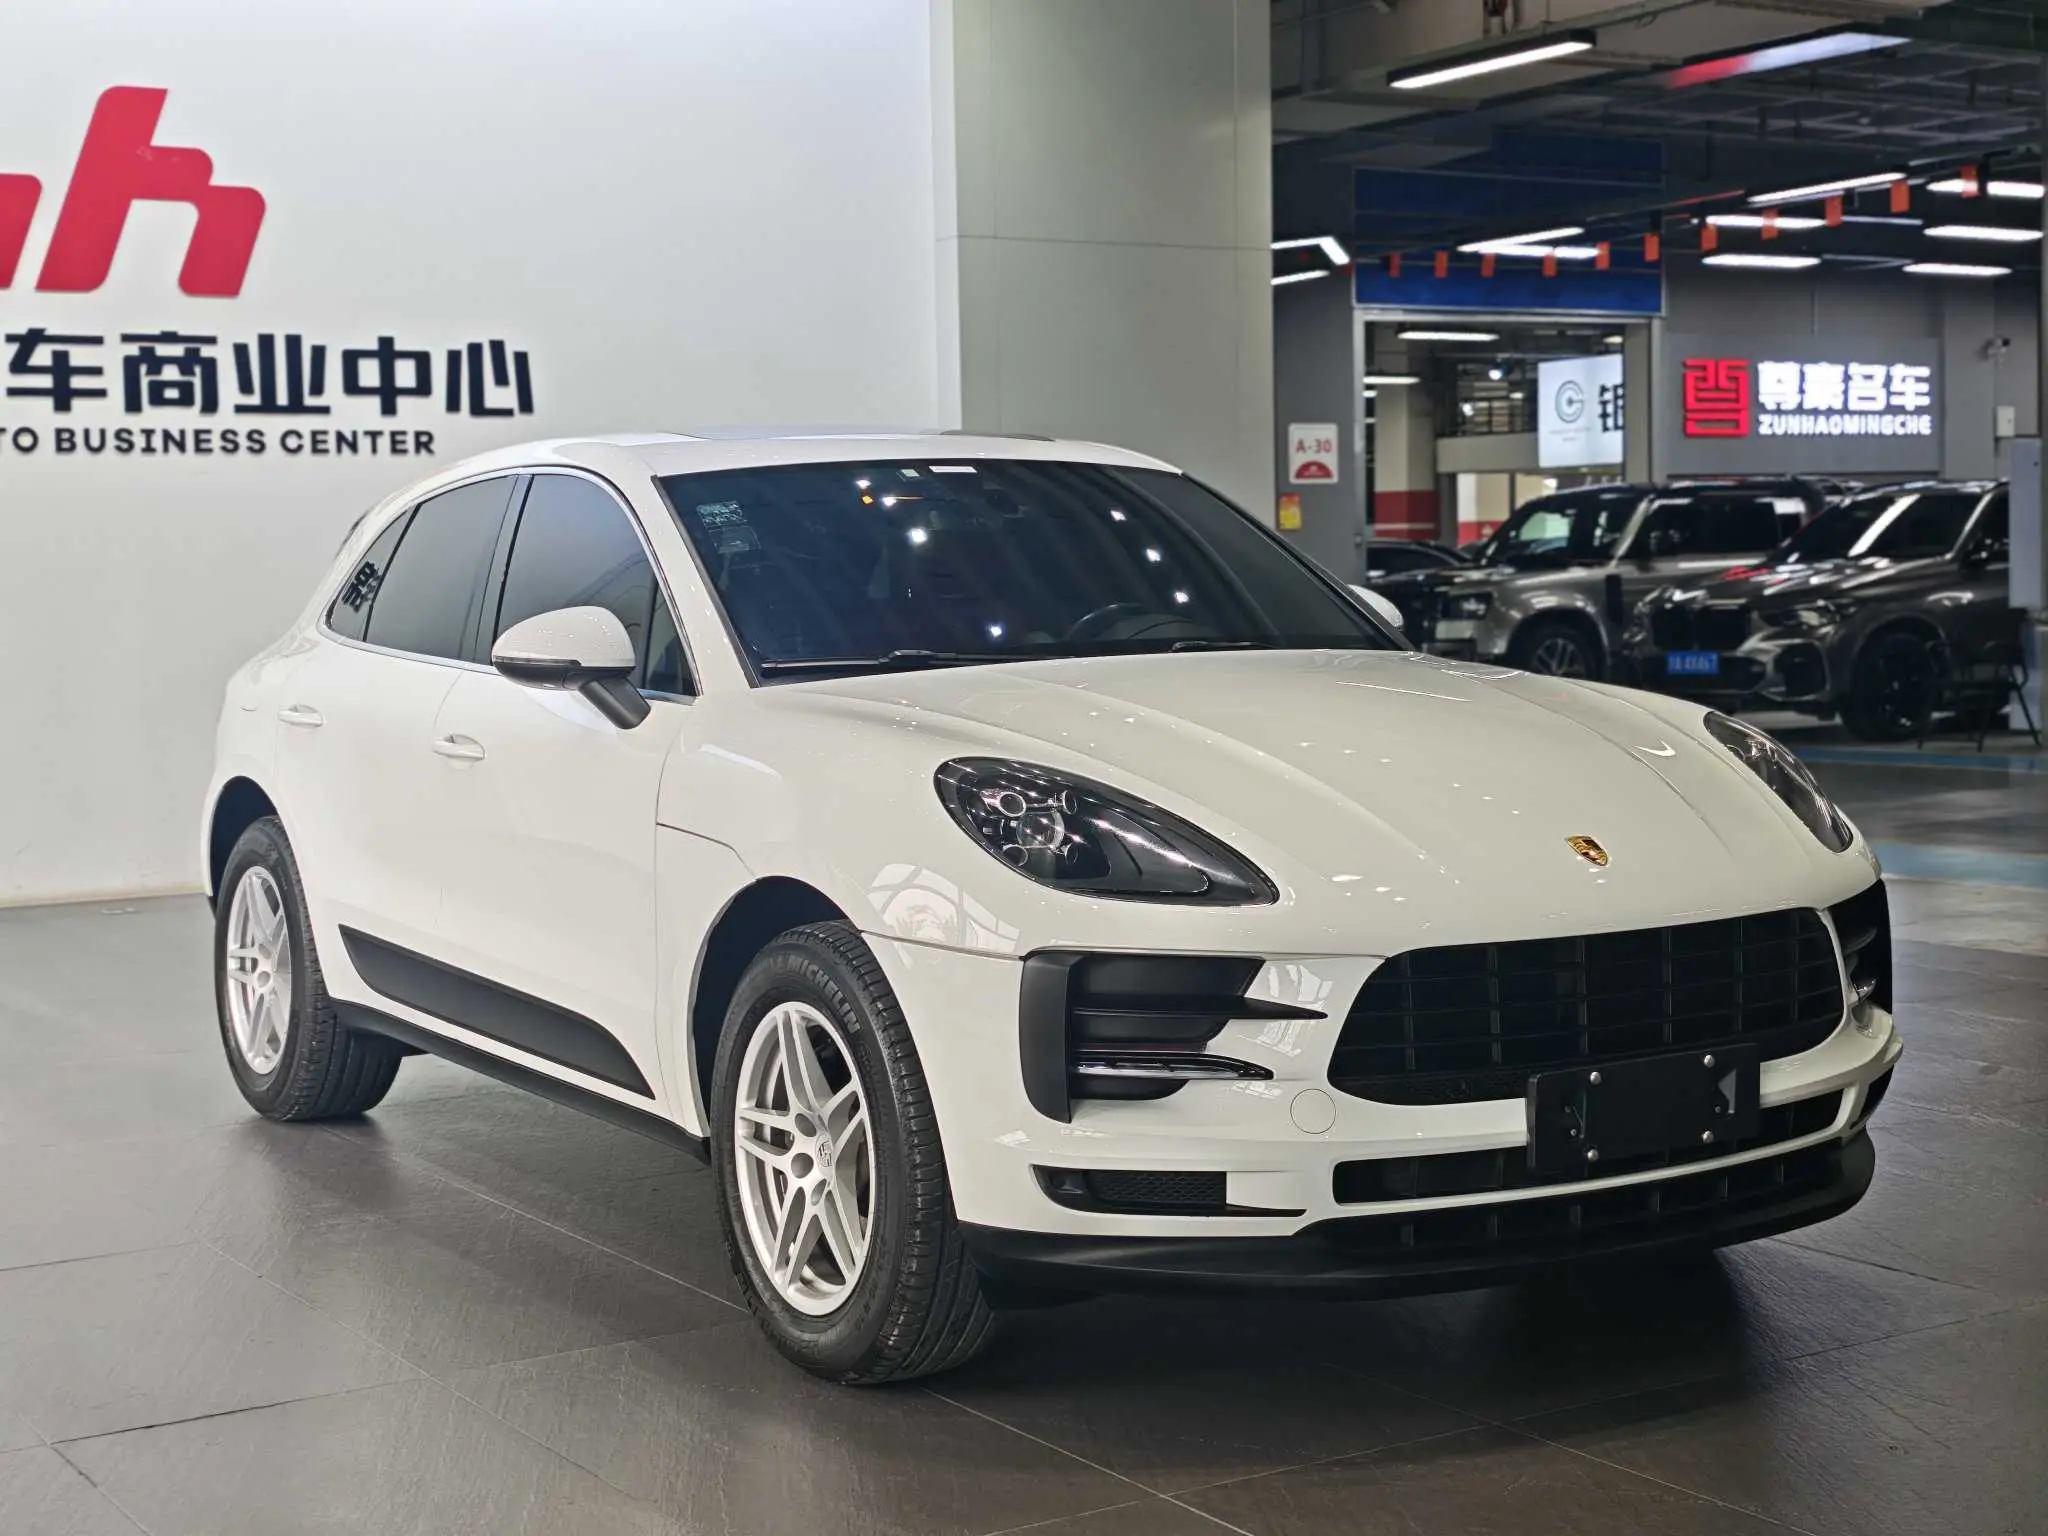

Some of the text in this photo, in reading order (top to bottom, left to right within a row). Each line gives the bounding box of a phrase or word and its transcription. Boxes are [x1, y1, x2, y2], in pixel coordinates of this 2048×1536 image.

[5, 328, 534, 417] 车商业中心
[1758, 414, 1932, 435] ZUNHAOMINGCHE
[55, 428, 267, 454] BUSINESS
[279, 429, 435, 455] CENTER
[1295, 438, 1332, 454] A-30
[786, 954, 861, 1034] MICHELIN
